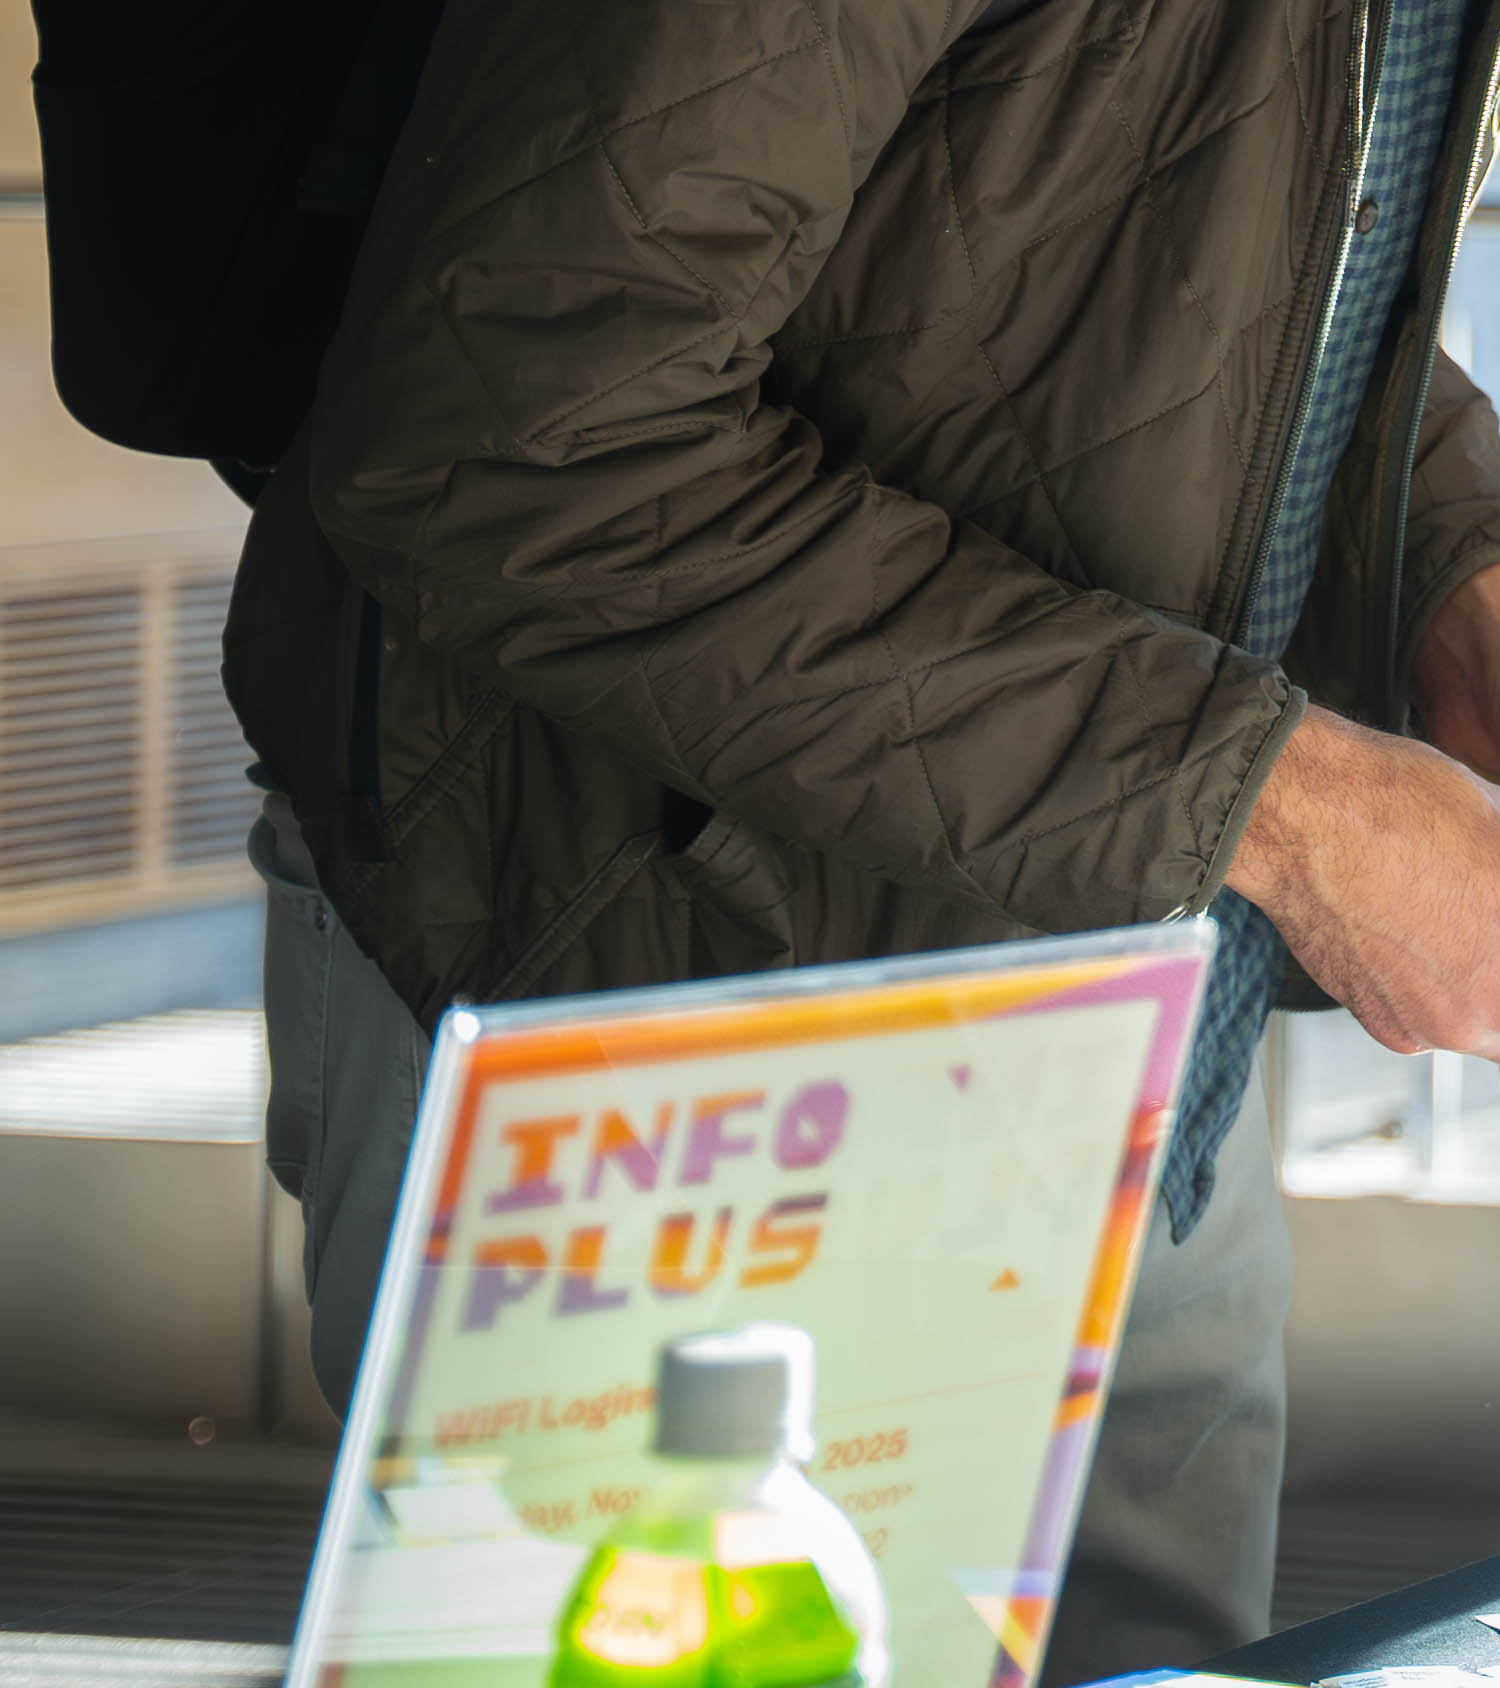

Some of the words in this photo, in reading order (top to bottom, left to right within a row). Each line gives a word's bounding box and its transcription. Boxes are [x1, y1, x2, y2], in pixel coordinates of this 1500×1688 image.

[485, 1078, 851, 1214] INFO
[457, 1191, 829, 1334] PLUS
[821, 1428, 909, 1472] 2025
